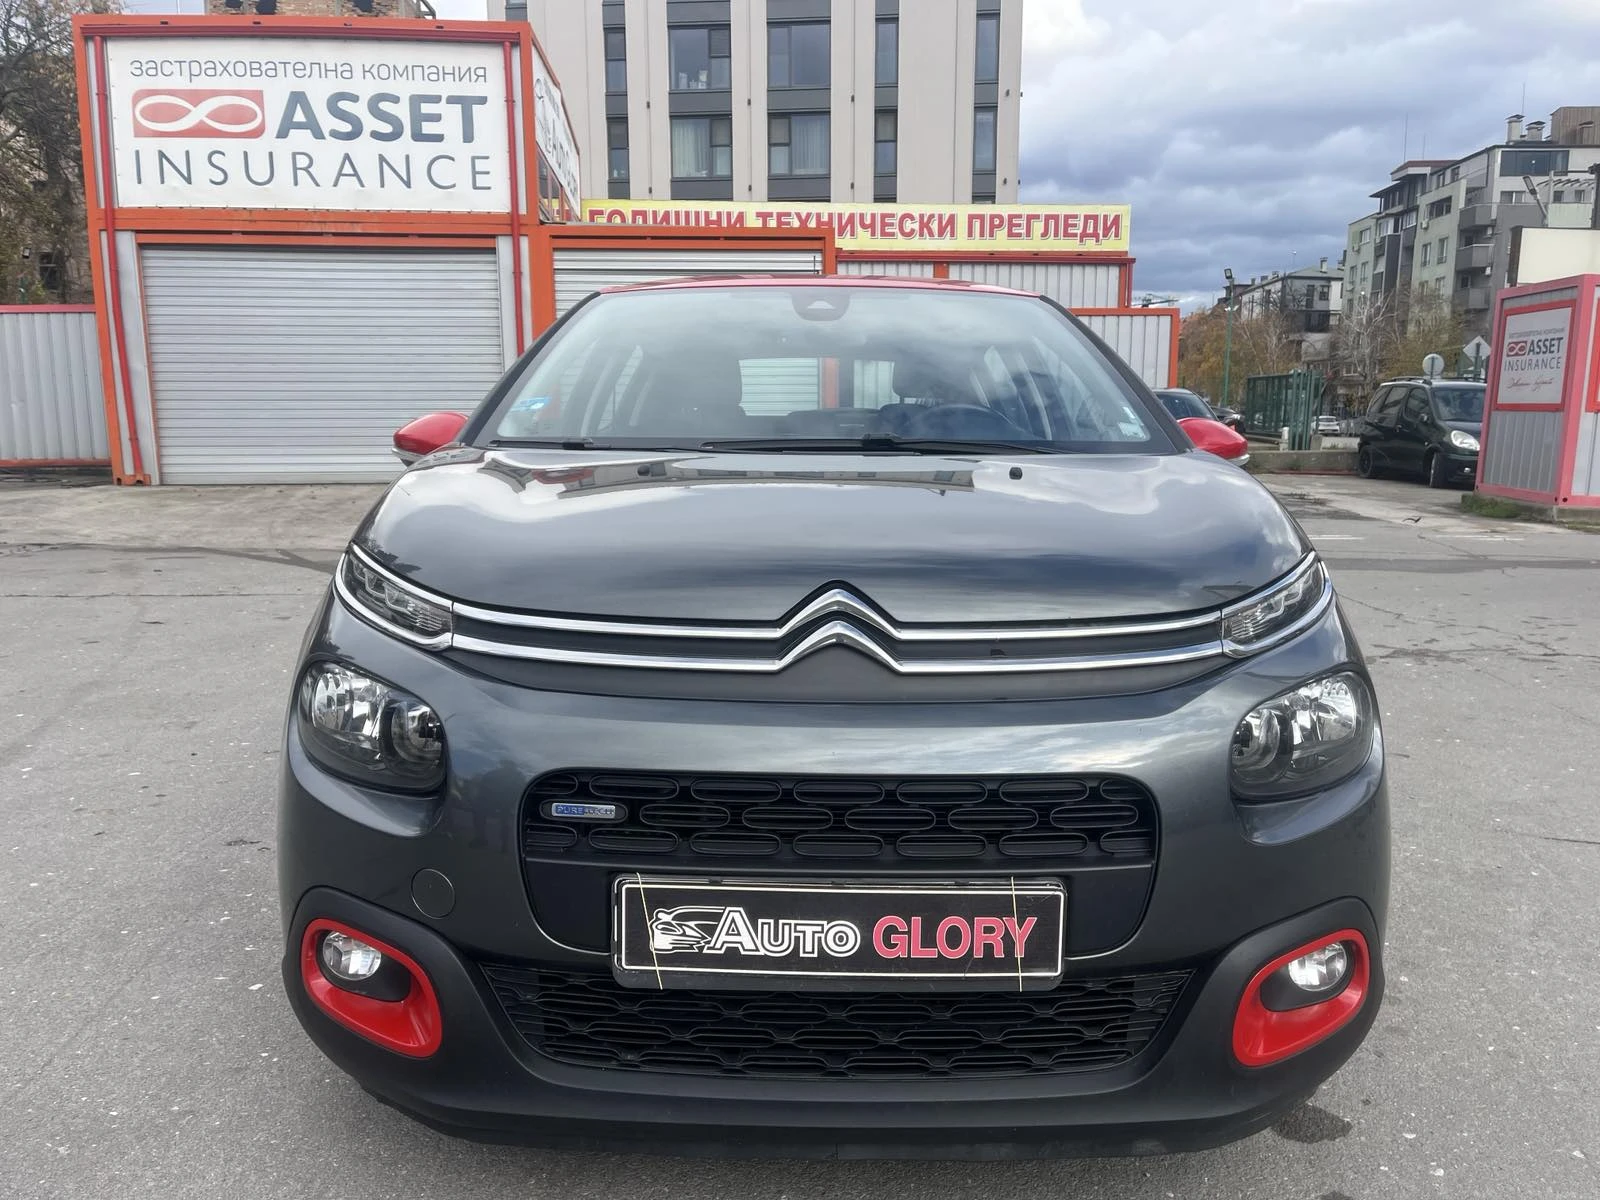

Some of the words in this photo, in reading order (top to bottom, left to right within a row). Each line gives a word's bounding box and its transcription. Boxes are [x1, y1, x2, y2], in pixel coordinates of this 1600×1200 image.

[129, 59, 353, 82] застрахователна
[362, 62, 488, 83] компания
[275, 90, 488, 144] ASSET
[134, 149, 492, 191] INSURANCE
[966, 213, 1122, 244] ПРЕГЛЕДИ
[1527, 337, 1564, 356] ASSET
[1504, 356, 1562, 372] INSURANCE
[872, 915, 1038, 959] GLORY
